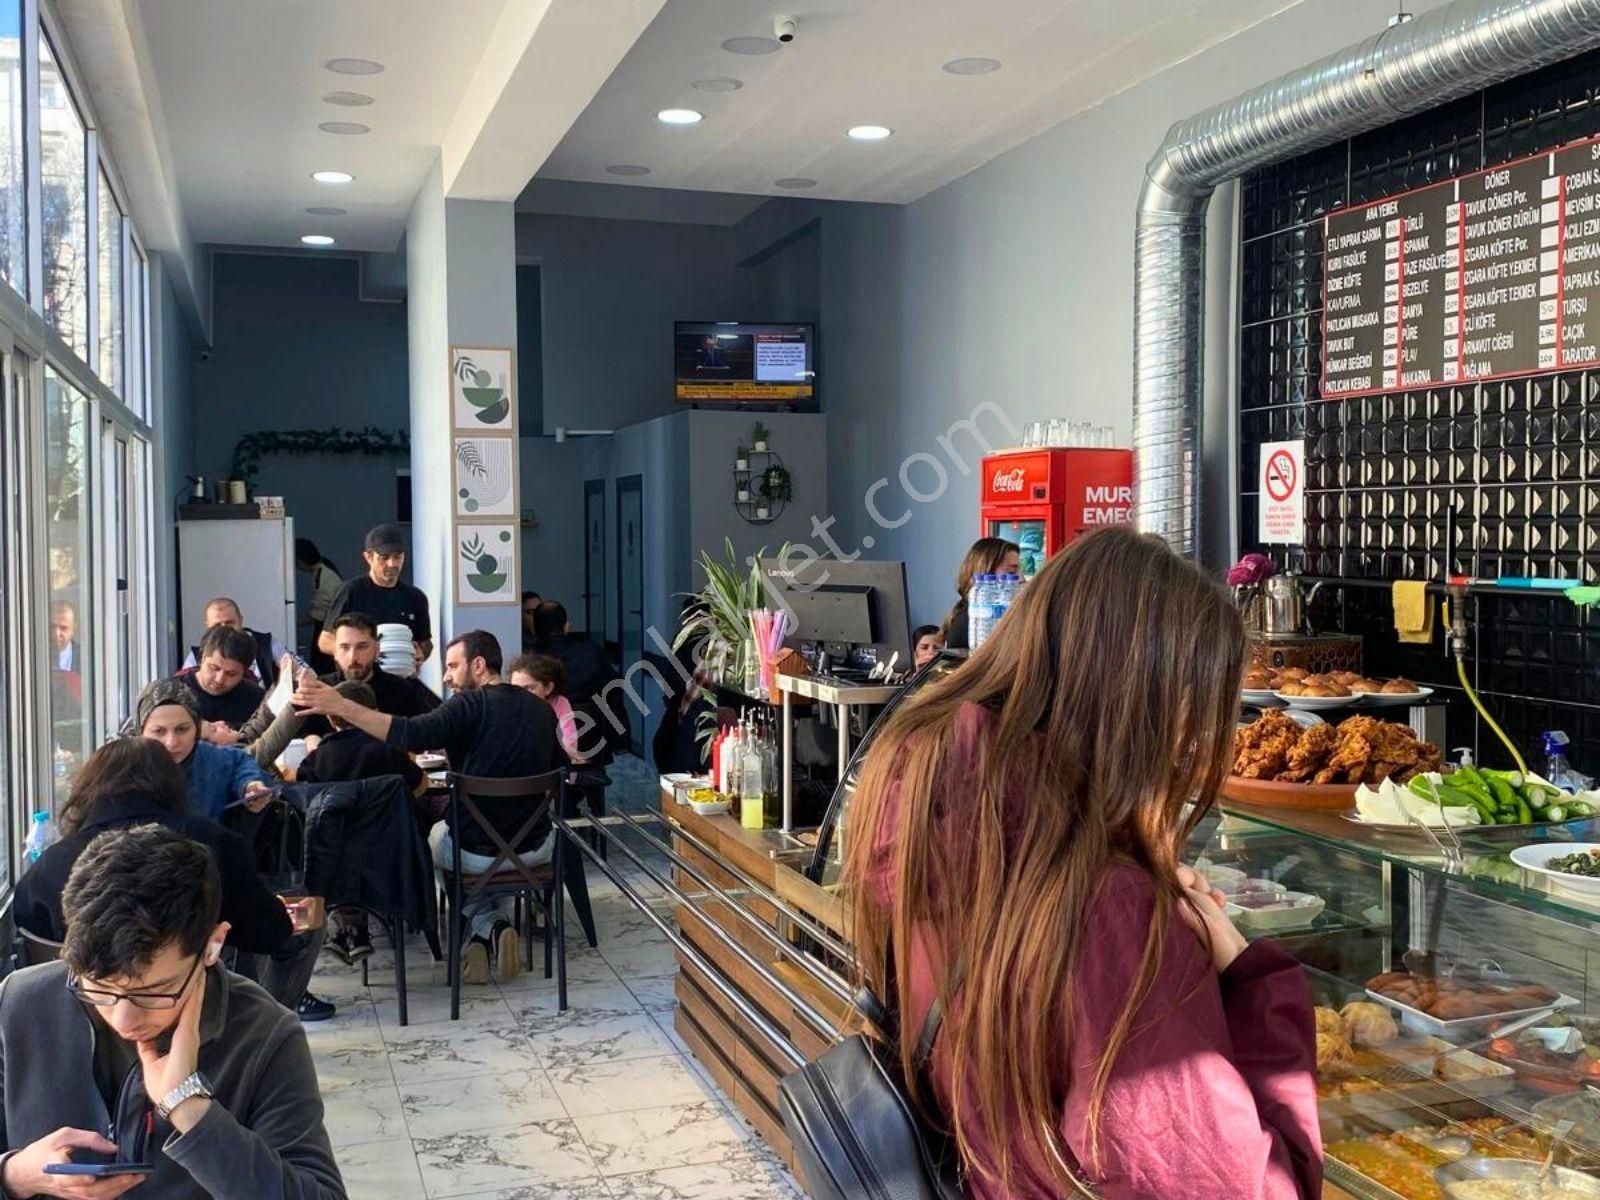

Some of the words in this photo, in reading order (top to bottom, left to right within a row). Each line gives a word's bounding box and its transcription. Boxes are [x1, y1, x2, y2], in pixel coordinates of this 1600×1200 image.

[1485, 170, 1510, 190] DÖNER
[1565, 170, 1592, 195] ÇOBAN
[1365, 206, 1378, 221] ANA
[1378, 201, 1399, 217] YEMEK
[1465, 199, 1487, 217] TAVUK
[1487, 192, 1513, 211] DÖNER
[1465, 221, 1486, 240] TAVUK
[1487, 215, 1512, 235] DÖNER
[1513, 206, 1540, 229] DÜRÜM
[1490, 238, 1514, 257] KÖFTE
[1343, 272, 1362, 289] KÖFTE
[1487, 262, 1508, 281] KÖFTE
[1562, 271, 1593, 291] YAPRAK
[1327, 293, 1361, 313] KAVURMA
[1487, 287, 1508, 305] KÖFTE
[1562, 297, 1588, 317] TURŞU
[1475, 312, 1496, 331] KÖFTE
[1561, 345, 1596, 364] TARATOR
